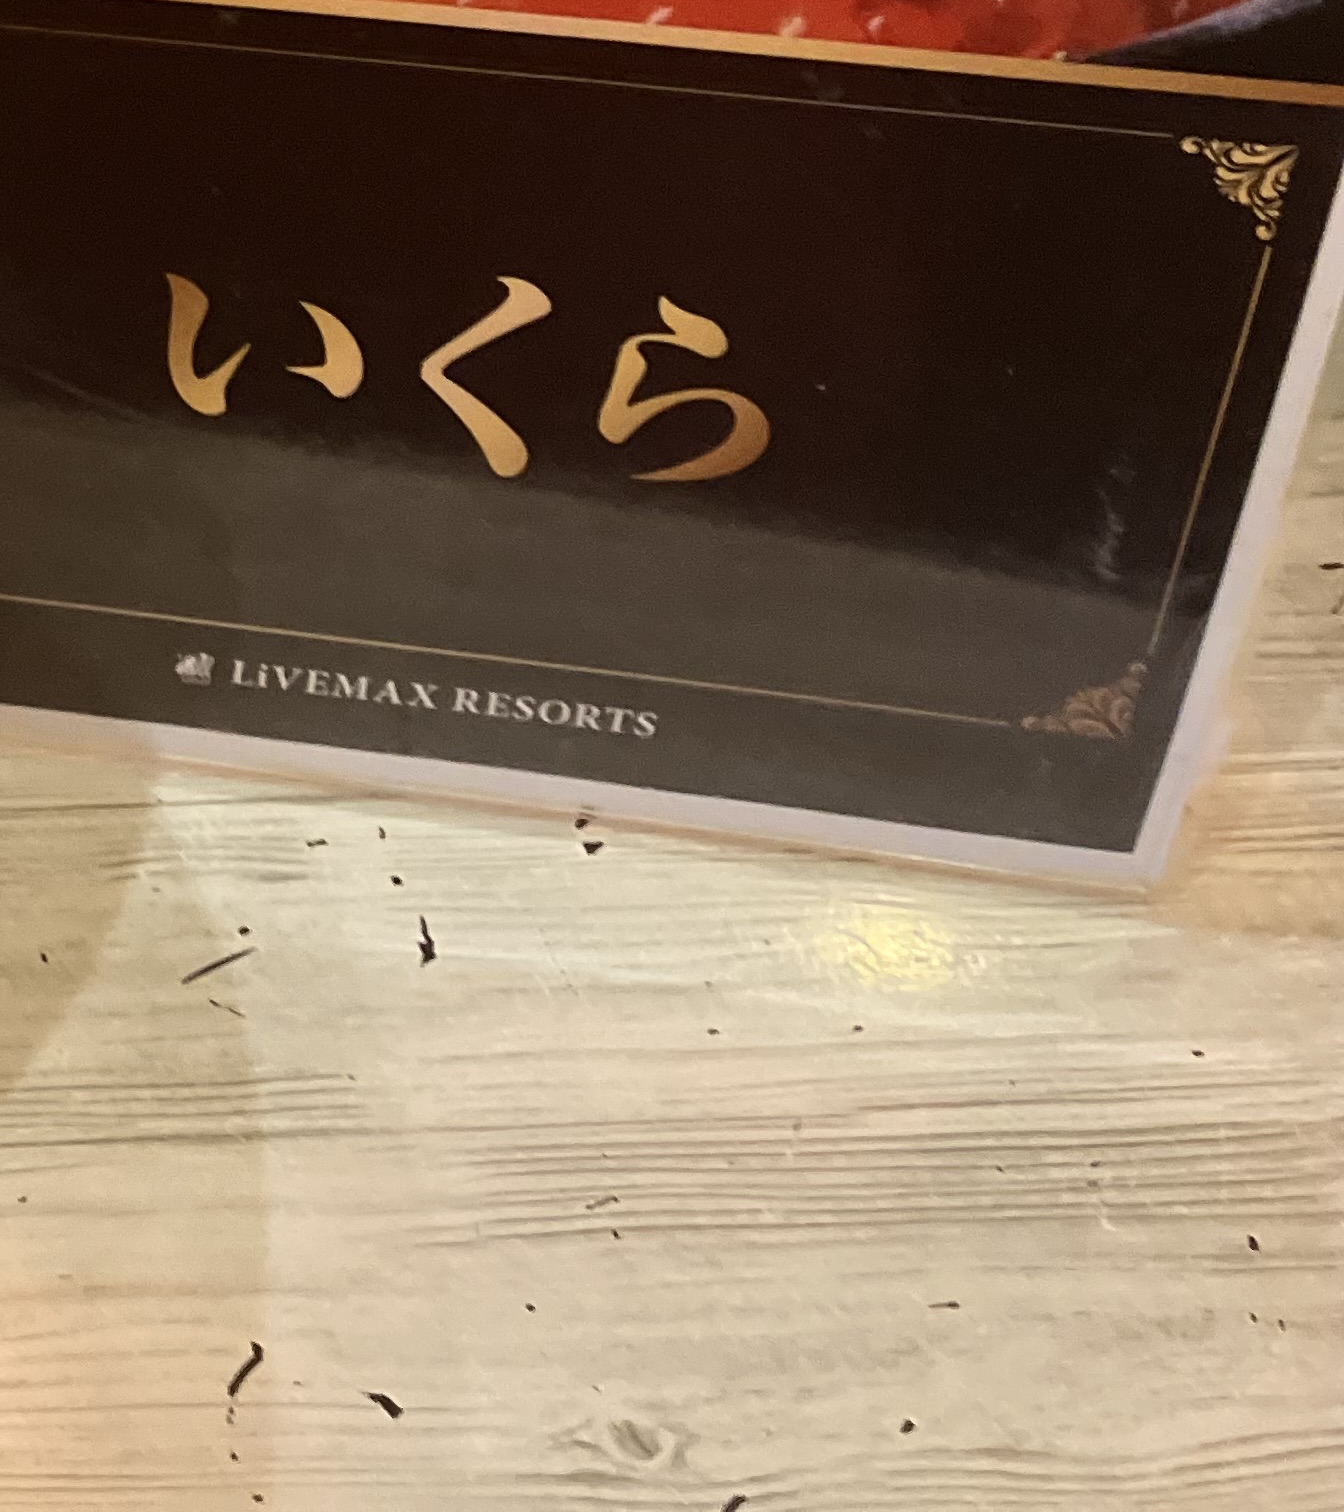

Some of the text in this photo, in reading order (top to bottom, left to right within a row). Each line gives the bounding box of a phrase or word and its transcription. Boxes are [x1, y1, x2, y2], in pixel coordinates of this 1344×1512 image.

[163, 271, 771, 482] いくら
[450, 685, 659, 740] RESORTS
